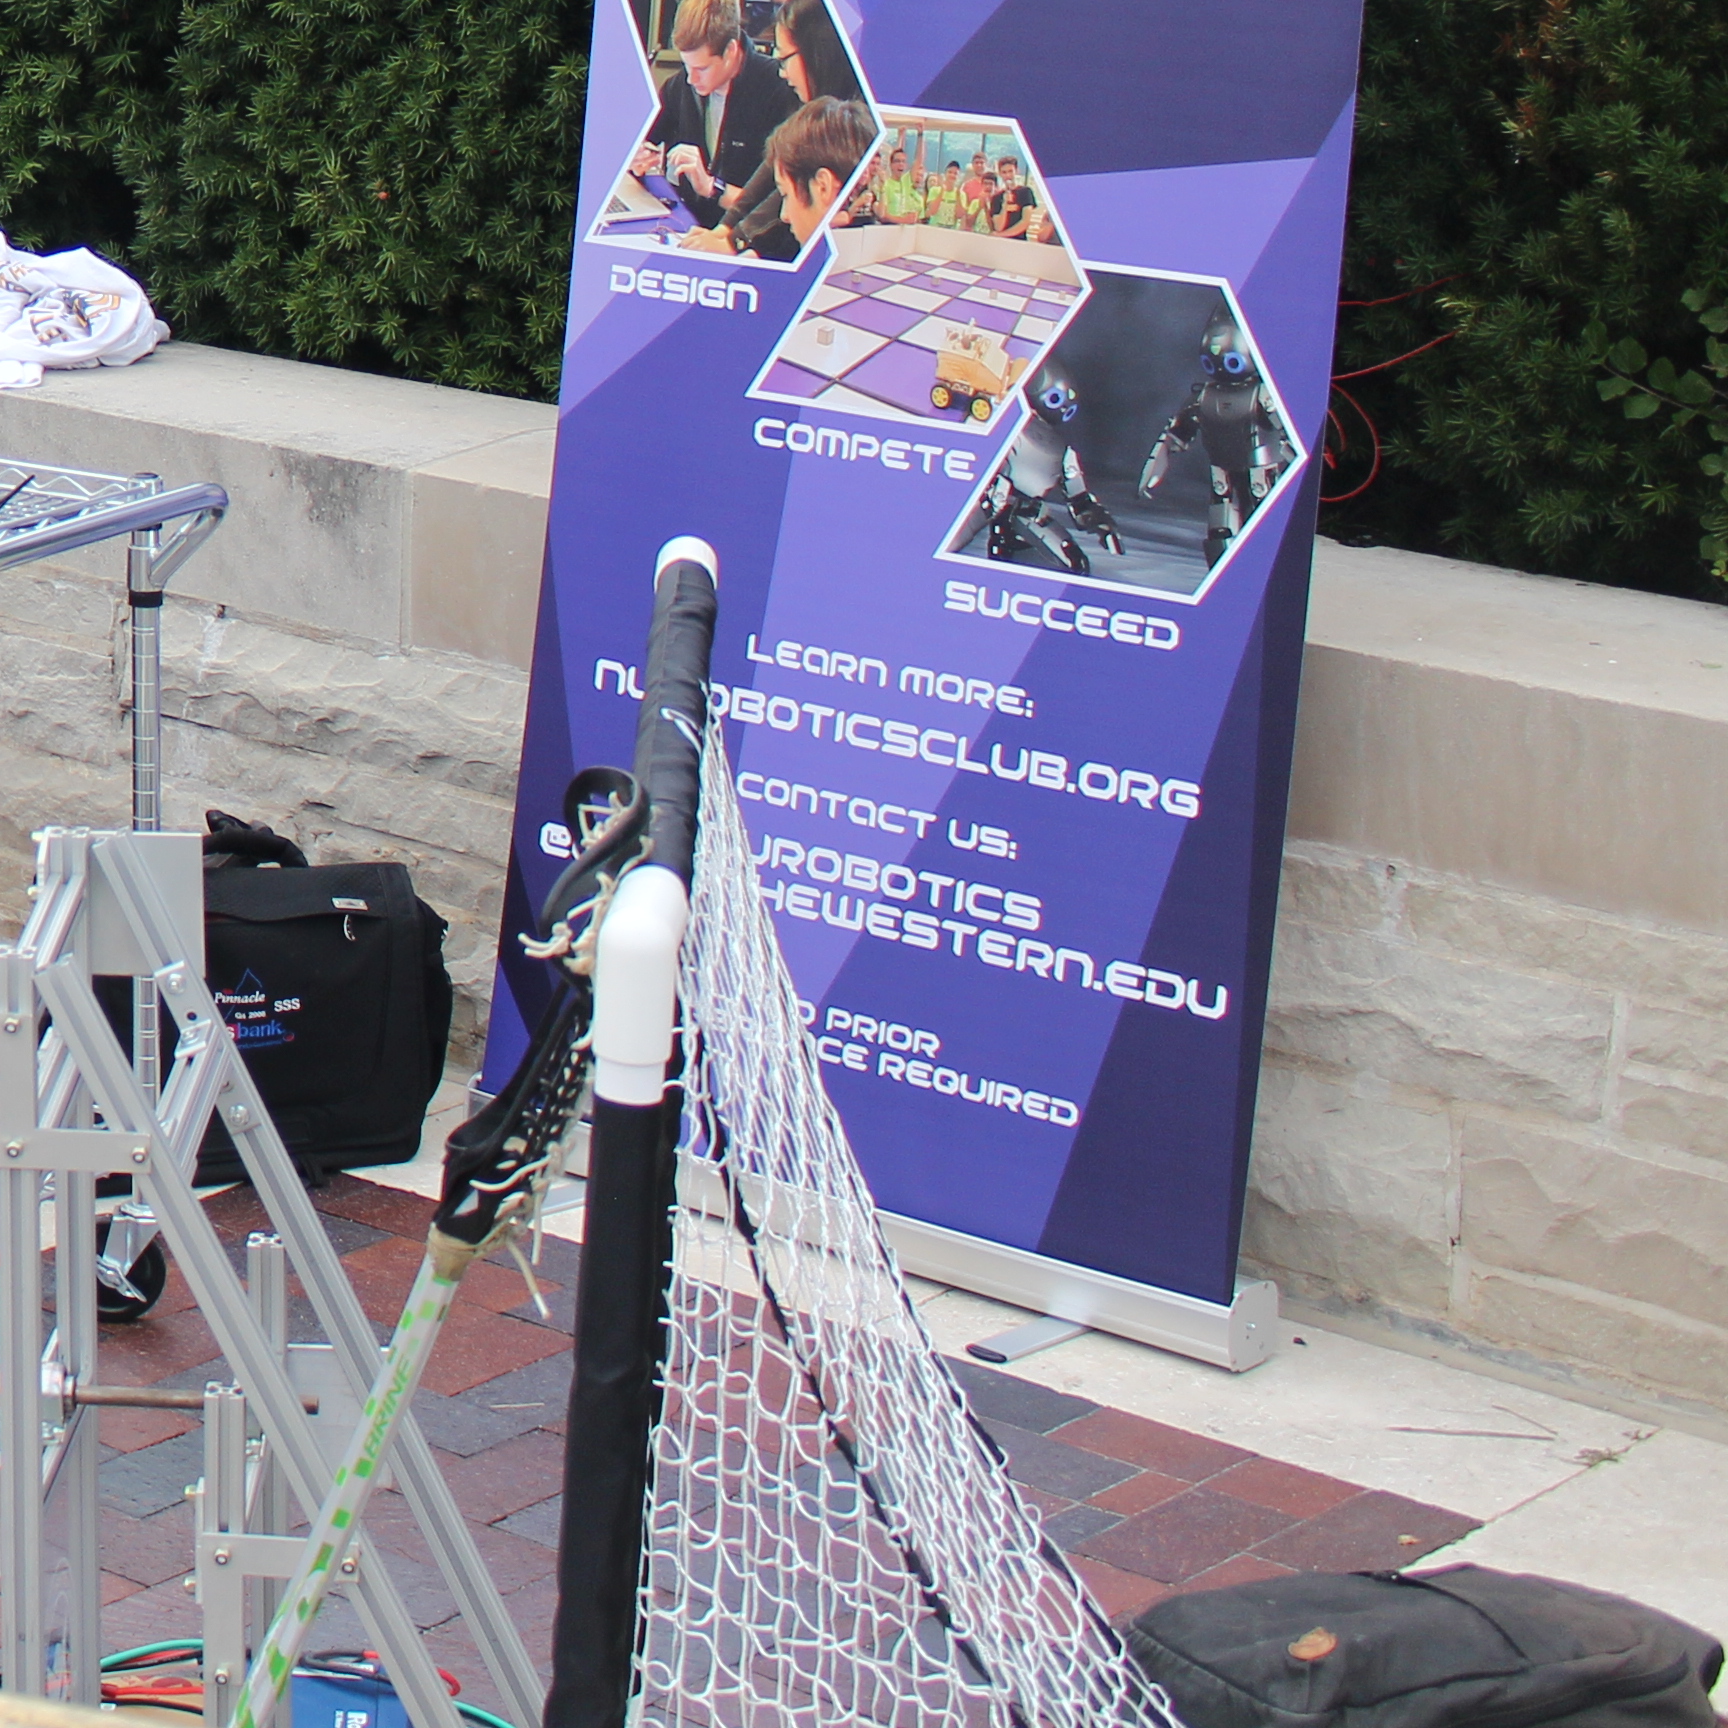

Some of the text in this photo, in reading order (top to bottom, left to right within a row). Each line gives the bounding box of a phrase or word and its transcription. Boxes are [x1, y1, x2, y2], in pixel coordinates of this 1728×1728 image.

[609, 264, 758, 313] DESIGN
[754, 418, 976, 481] COMPETE
[944, 580, 1179, 650] SUCCEED
[747, 634, 1034, 718] LEARN MORE:
[594, 658, 1201, 818] NUOBOTICSCLUB.ORG
[735, 770, 1017, 860] CONTACT US:
[758, 878, 1228, 1019] HEWESTERN.EDU
[214, 991, 266, 1004] Pinnacle
[825, 1006, 940, 1058] PRIOR
[878, 1052, 1079, 1127] REQUIRED
